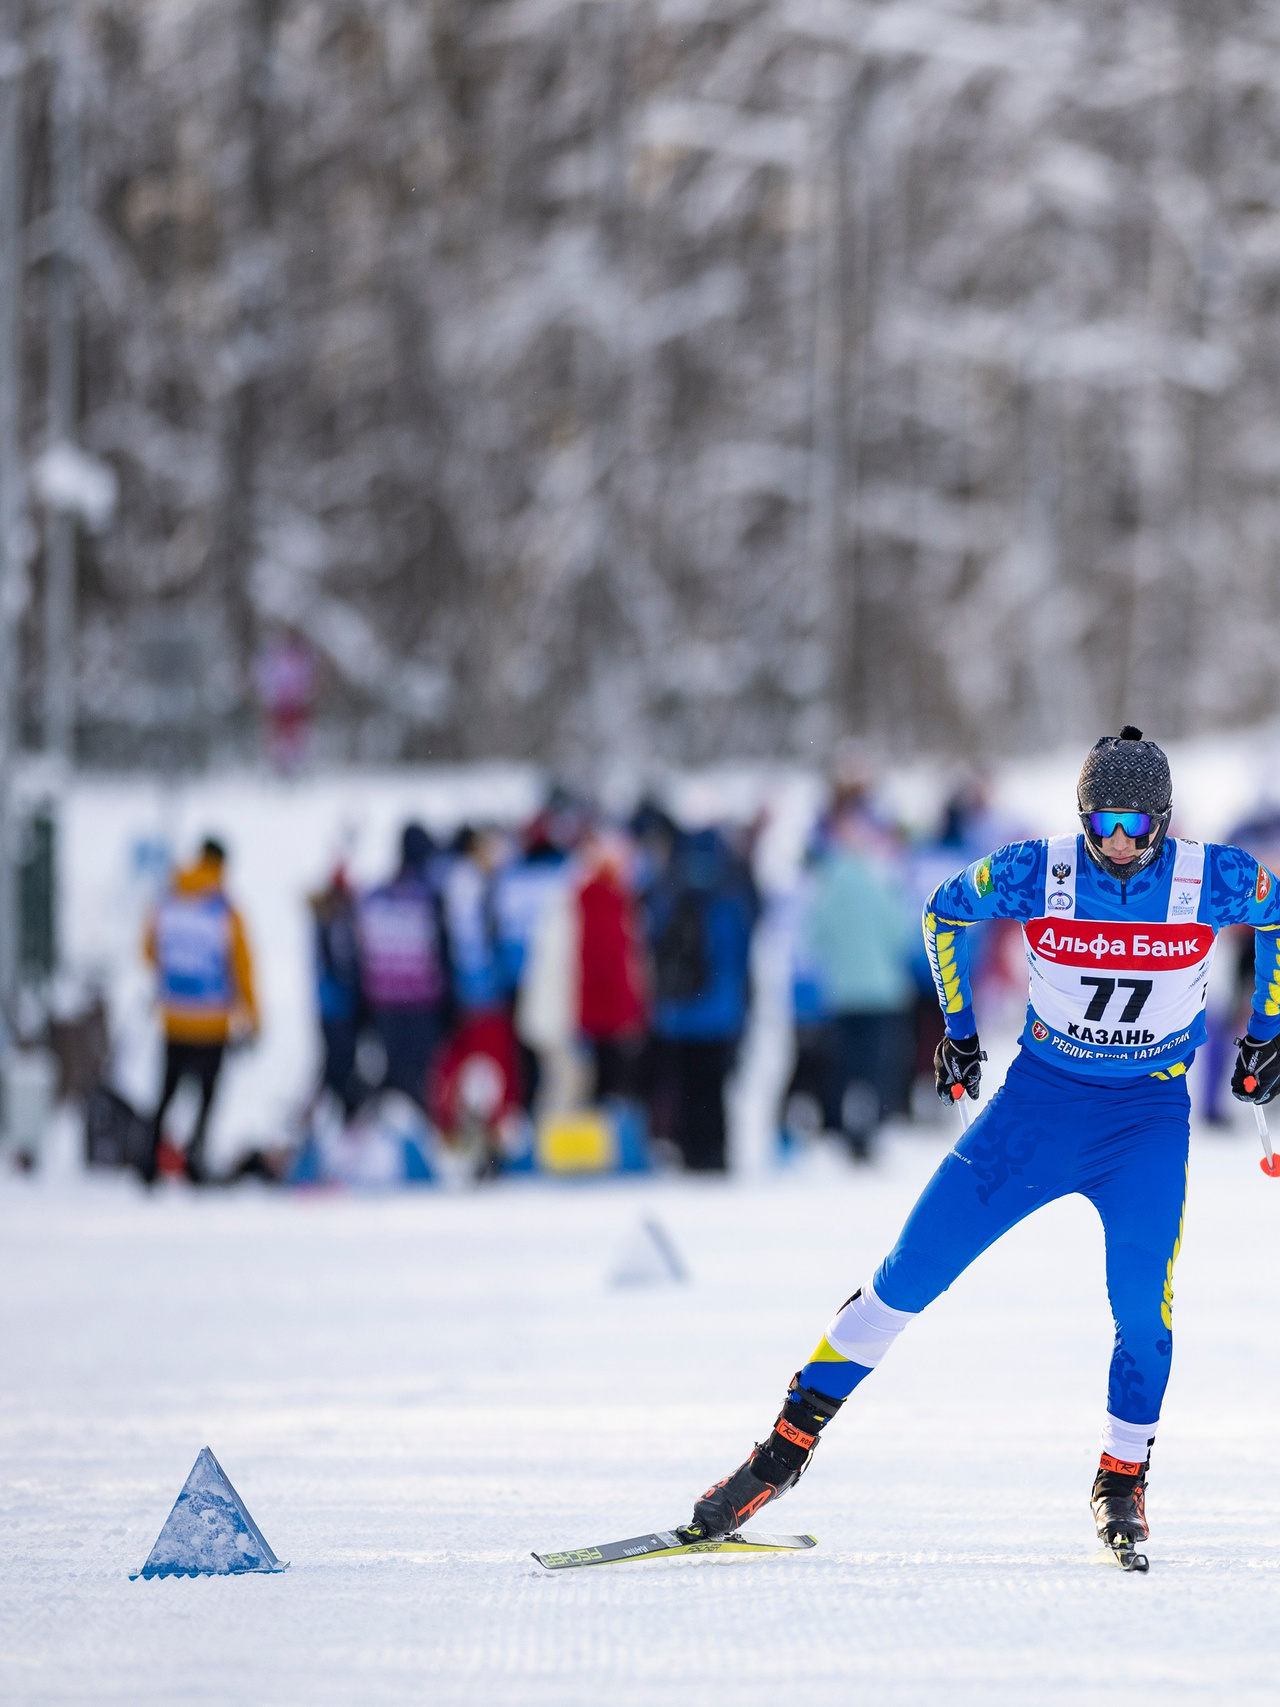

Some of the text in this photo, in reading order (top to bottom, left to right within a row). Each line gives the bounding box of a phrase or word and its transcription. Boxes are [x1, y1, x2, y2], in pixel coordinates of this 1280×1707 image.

[1037, 928, 1201, 960] Альфа Банк
[1080, 976, 1153, 1024] 77
[1067, 1021, 1155, 1045] КАЗАНЬ
[1134, 1030, 1190, 1060] ТАТАРСТАН
[543, 1547, 603, 1566] FISCHER
